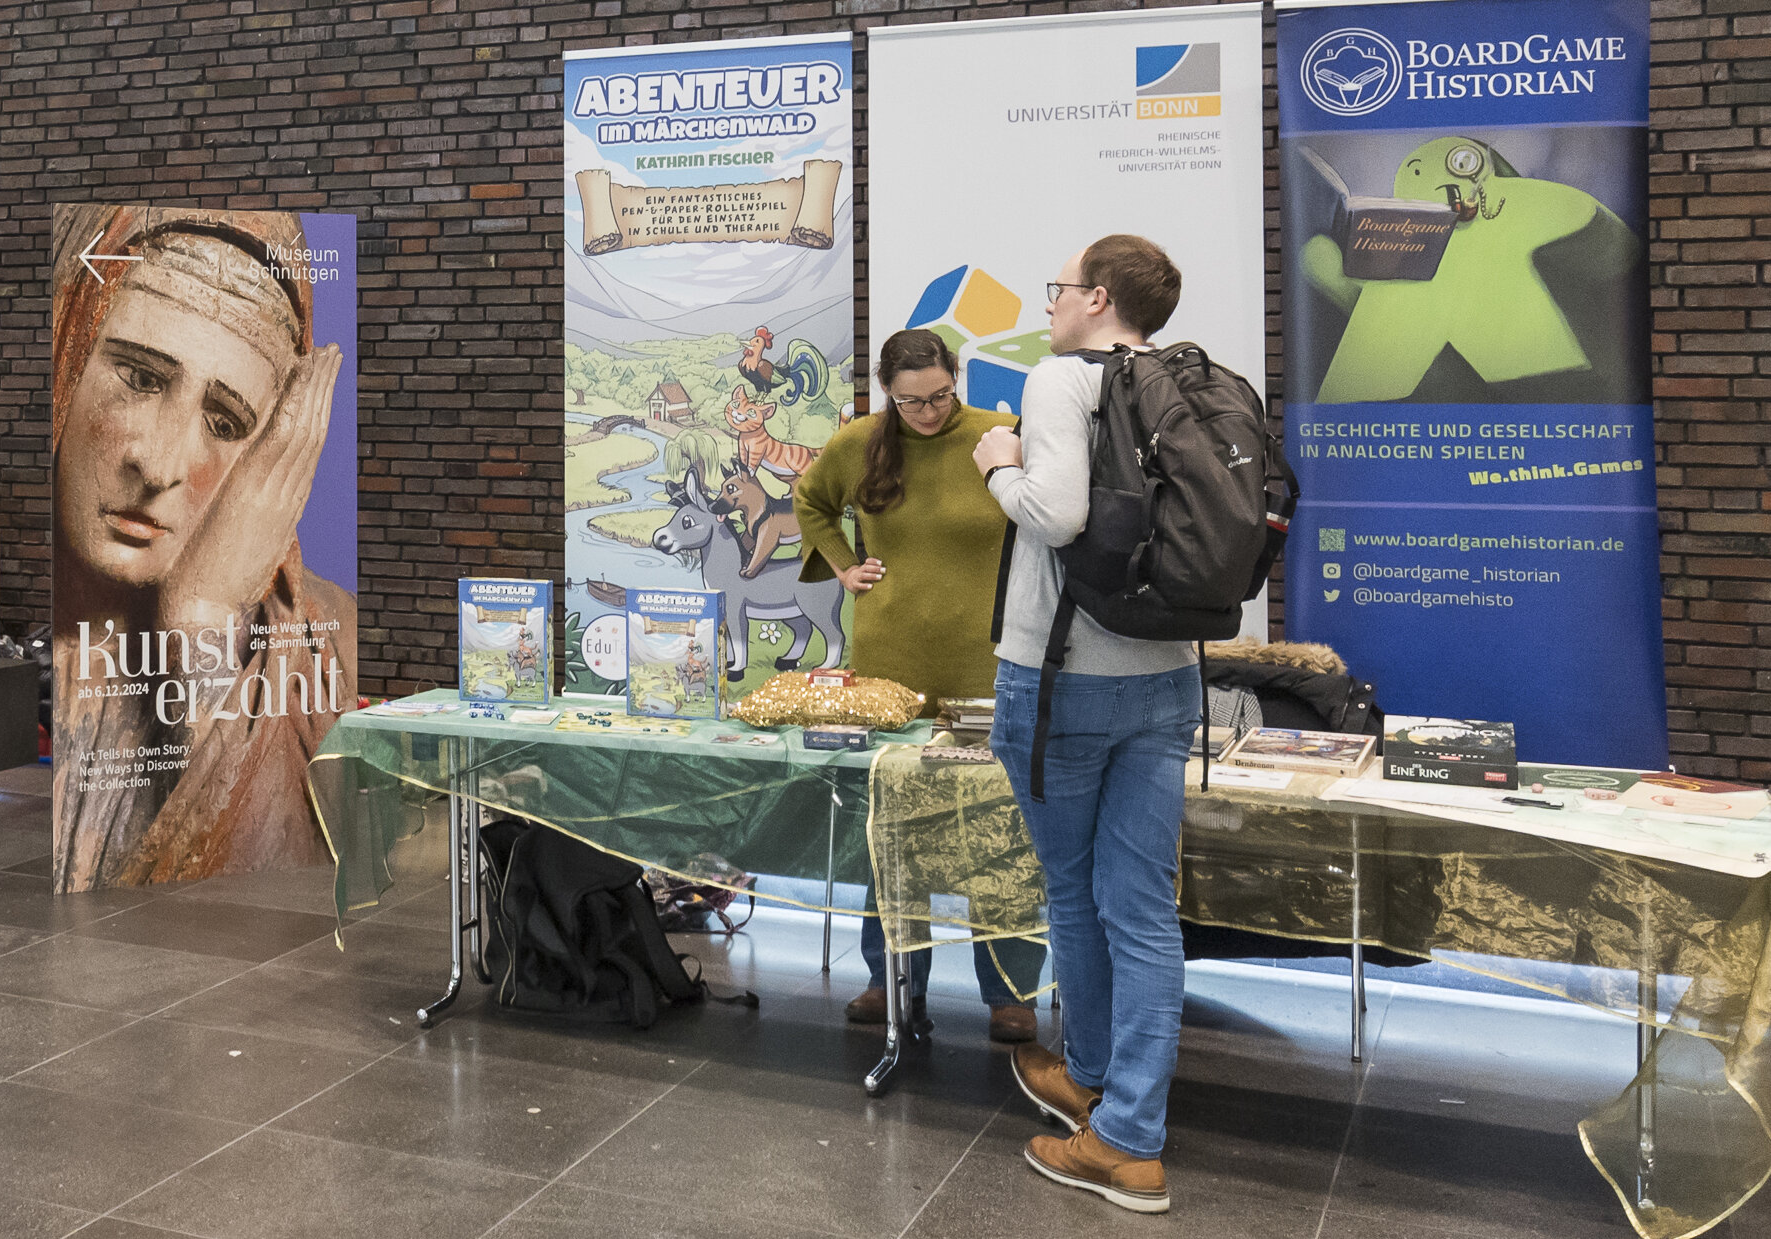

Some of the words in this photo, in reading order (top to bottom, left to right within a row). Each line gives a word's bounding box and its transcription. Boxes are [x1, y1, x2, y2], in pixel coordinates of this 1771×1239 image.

[574, 63, 841, 117] ABENTEUER
[1007, 101, 1132, 123] UNIVERSITÄT
[1139, 99, 1198, 117] BONN
[1158, 131, 1221, 142] RHEINISCHE
[1099, 145, 1221, 159] FRIEDRICH-WILHELMS-
[1118, 160, 1187, 173] UNIVERSITÄT
[1190, 160, 1222, 170] BONN
[645, 195, 665, 205] EIN
[671, 192, 762, 203] FANTASTISCHES
[652, 214, 672, 225] FÜR
[679, 214, 701, 223] DEN
[707, 213, 755, 223] EINSATZ
[1356, 217, 1450, 235] Boardgame
[628, 227, 640, 236] IN
[644, 226, 689, 235] SCHULE
[695, 225, 718, 234] UND
[725, 223, 780, 233] THERAPIE
[266, 243, 339, 262] Museum
[1354, 237, 1426, 252] Historian
[249, 262, 339, 284] Schnütgen
[1299, 423, 1421, 438] GESCHICHTE
[1428, 424, 1472, 438] UND
[1479, 424, 1635, 439] GESELLSCHAFT
[1300, 445, 1319, 458] IN
[1327, 445, 1433, 459] ANALOGEN
[1441, 446, 1525, 460] SPIELEN
[1469, 460, 1643, 486] We.think.Games
[1354, 532, 1624, 552] www.boardgamehistorian.de
[1353, 587, 1514, 607] @boardgamehisto
[250, 623, 278, 636] Neue
[280, 621, 308, 635] Wege
[310, 620, 340, 632] durch
[77, 614, 241, 680] Kunst
[250, 638, 267, 649] die
[269, 636, 325, 650] Sammlung
[78, 686, 93, 699] ab
[95, 683, 149, 697] 6.12.2024
[156, 653, 343, 725] erzählt
[79, 750, 96, 762] Art
[97, 748, 120, 760] Tells
[122, 748, 136, 758] Its
[137, 746, 161, 757] Own
[163, 744, 192, 756] Story.
[79, 765, 102, 777] New
[104, 762, 132, 776] Ways
[134, 762, 145, 772] to
[147, 758, 190, 771] Discover
[1390, 765, 1415, 777] EINE
[1419, 768, 1449, 779] RING
[79, 781, 96, 792] the
[99, 776, 150, 791] Collection
